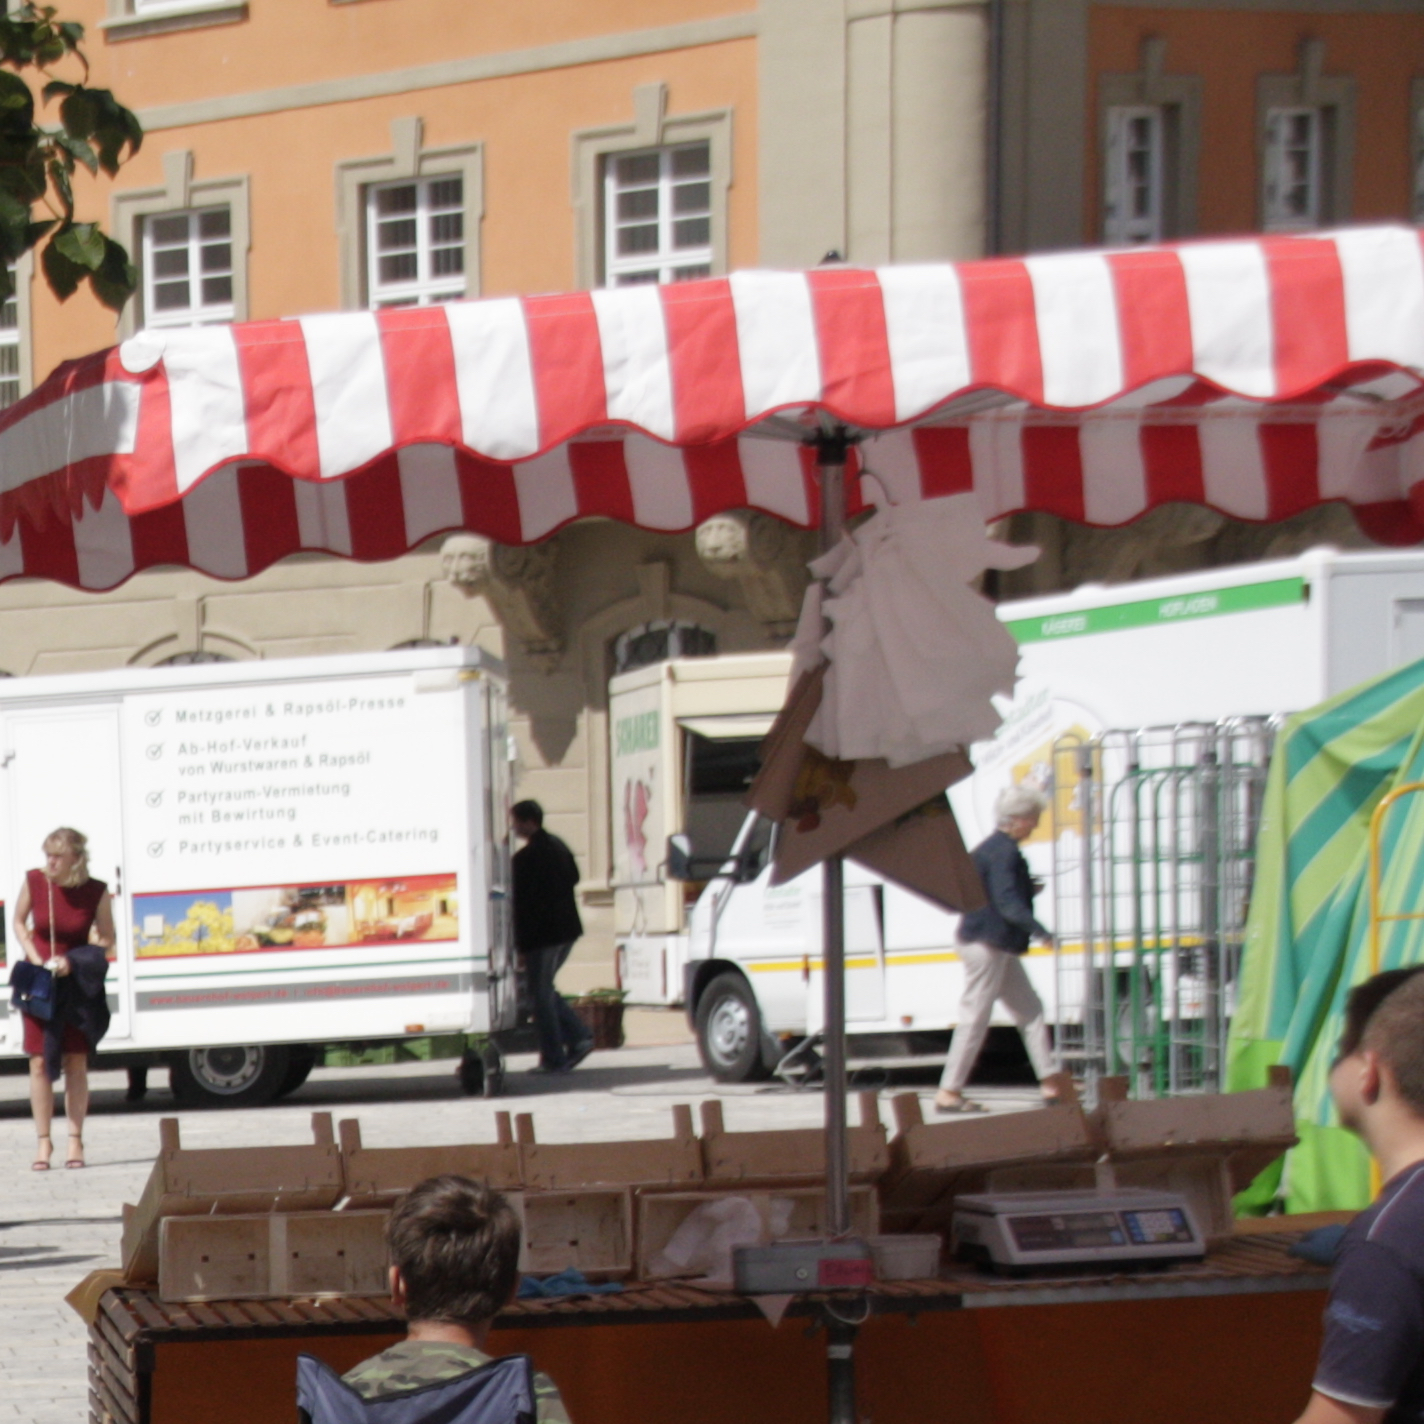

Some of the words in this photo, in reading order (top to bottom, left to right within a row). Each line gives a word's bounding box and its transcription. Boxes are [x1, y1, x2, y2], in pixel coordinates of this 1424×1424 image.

[176, 706, 257, 725] Metzgerei
[265, 703, 276, 717] &
[283, 697, 406, 718] Rapsöl-Presse
[177, 735, 308, 757] Ab-Hof-Verkauf
[178, 761, 205, 776] von
[210, 757, 298, 775] Wurstwaren
[303, 755, 313, 768] &
[319, 751, 371, 769] Rapsöl
[177, 781, 351, 806] Partyraum-Vermietung
[178, 811, 204, 826] mit
[211, 806, 297, 823] Bewirtung
[179, 836, 286, 856] Partyservice
[292, 834, 303, 848] &
[312, 828, 439, 847] Event-Catering
